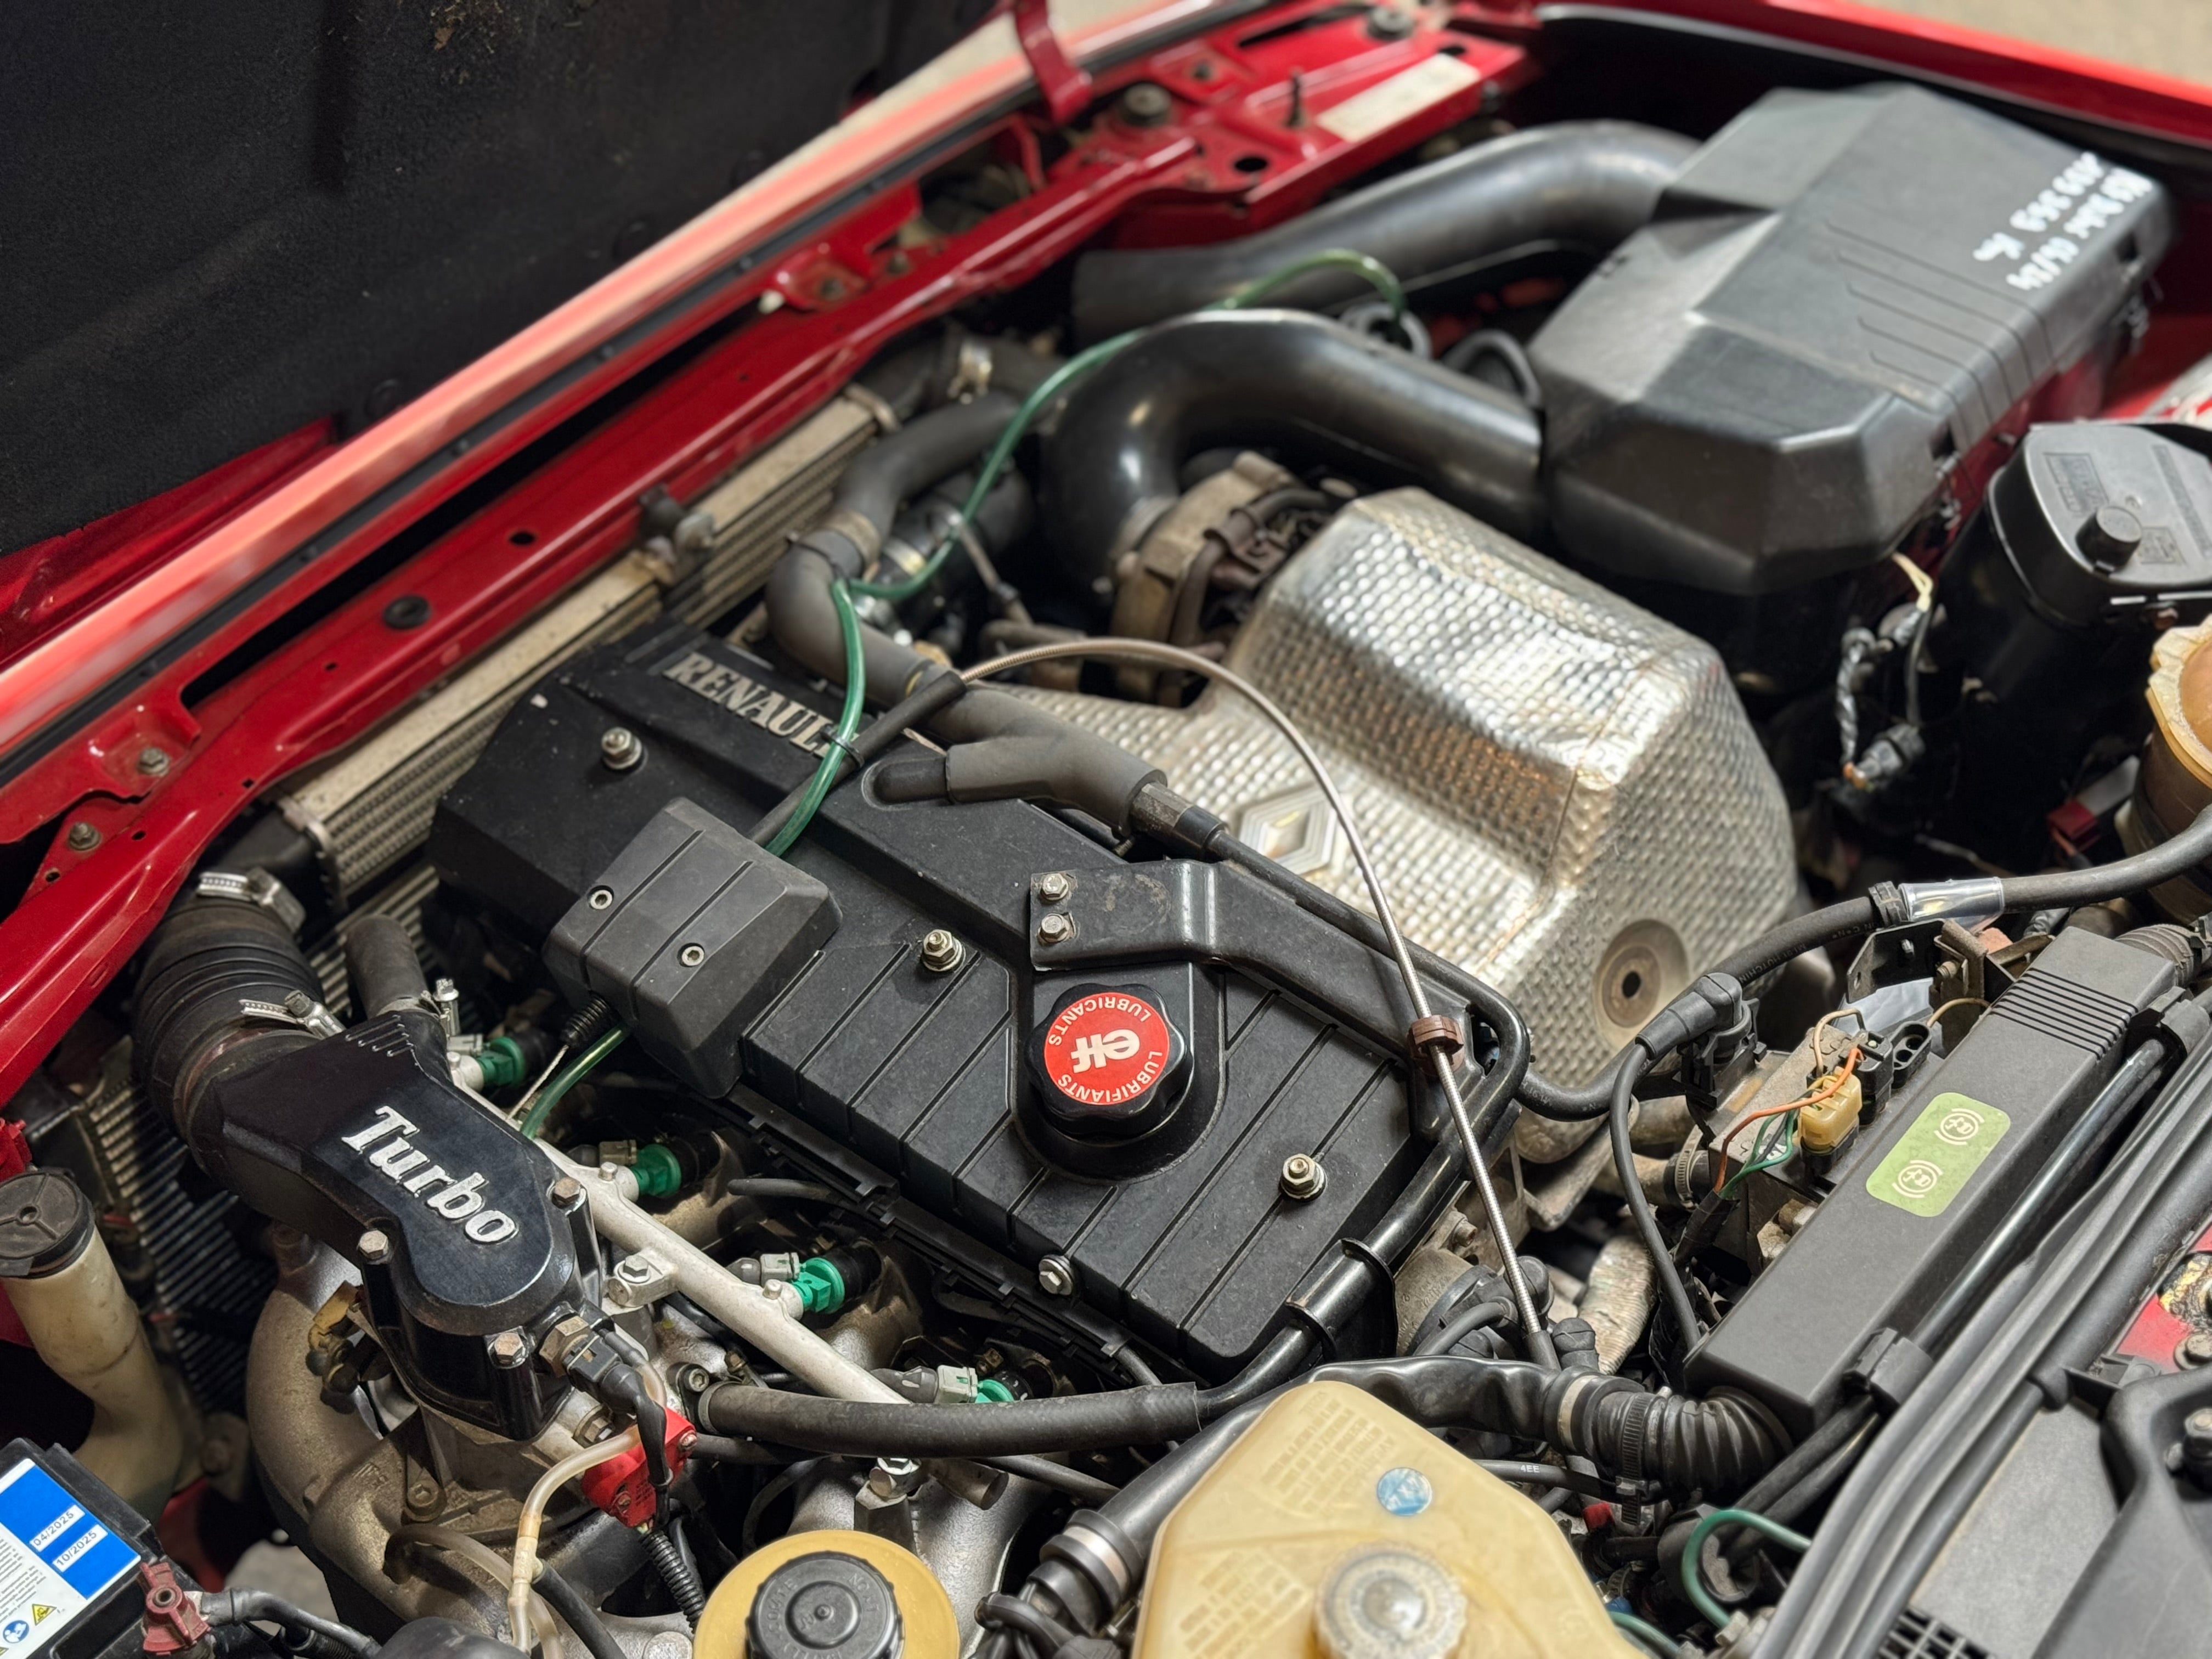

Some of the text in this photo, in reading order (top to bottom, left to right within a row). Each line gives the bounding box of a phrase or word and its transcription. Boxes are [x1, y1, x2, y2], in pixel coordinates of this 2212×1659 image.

[1048, 996, 1152, 1046] LUBRICANTS
[1070, 1029, 1140, 1074] elf
[1058, 1051, 1163, 1103] LUBRIFIANTS
[341, 1105, 517, 1243] Turbo
[1520, 1464, 1541, 1473] 4EE
[33, 1511, 74, 1546] 04/2025
[57, 1530, 97, 1566] 10/2025
